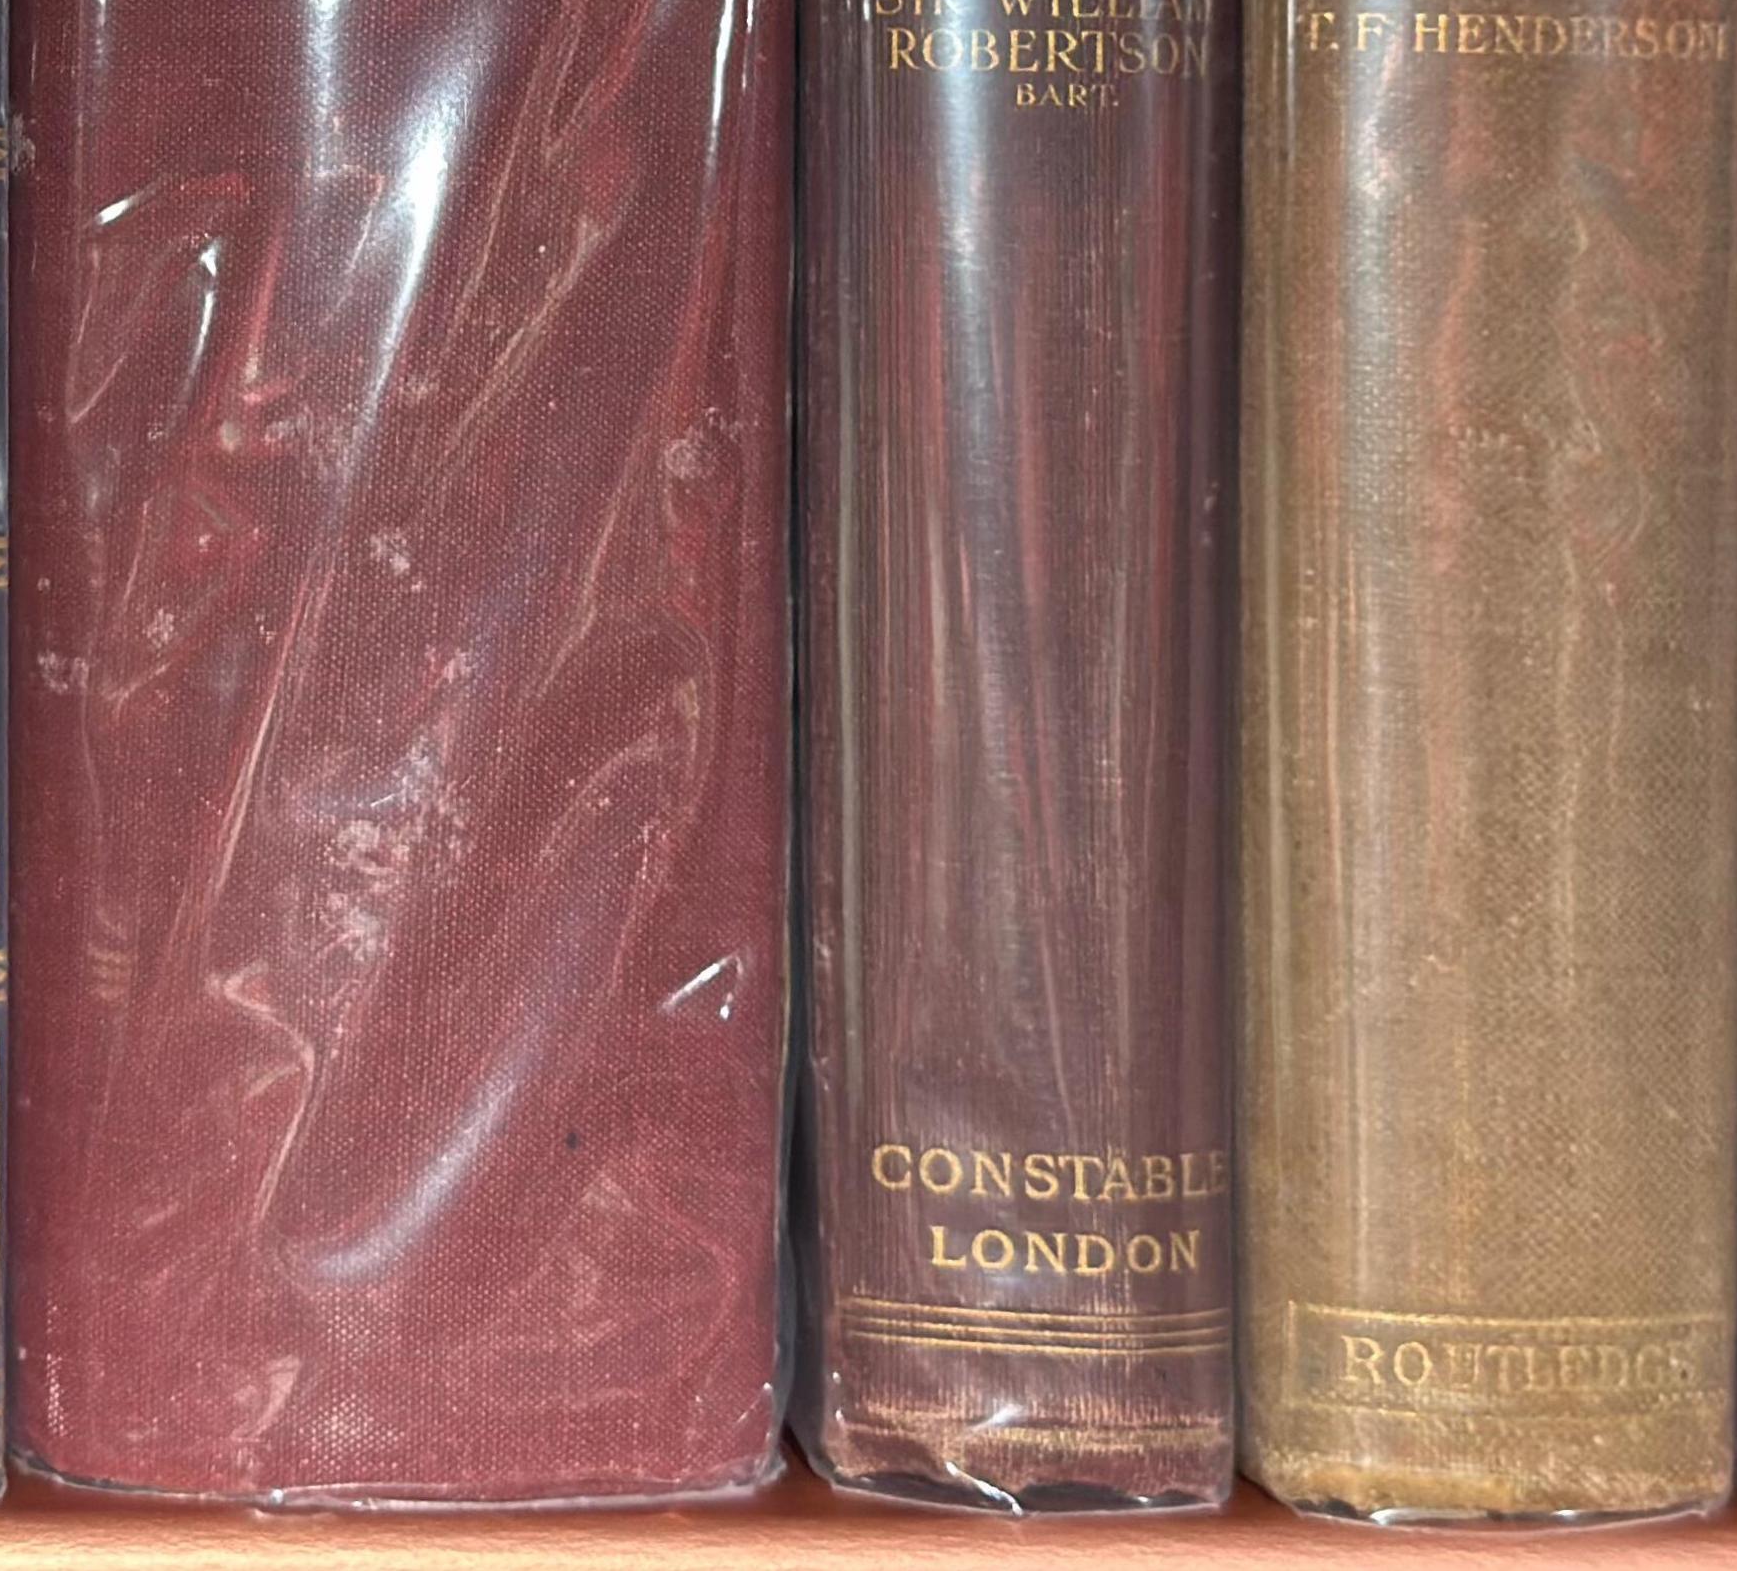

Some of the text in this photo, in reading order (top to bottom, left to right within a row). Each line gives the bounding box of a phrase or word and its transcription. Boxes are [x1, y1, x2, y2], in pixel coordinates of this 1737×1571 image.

[888, 27, 1210, 78] ROBERTSON
[1412, 12, 1729, 62] HENDERSON
[1015, 82, 1119, 108] BART.
[872, 1144, 1225, 1201] CONSTABLE
[931, 1225, 1202, 1275] LONDON
